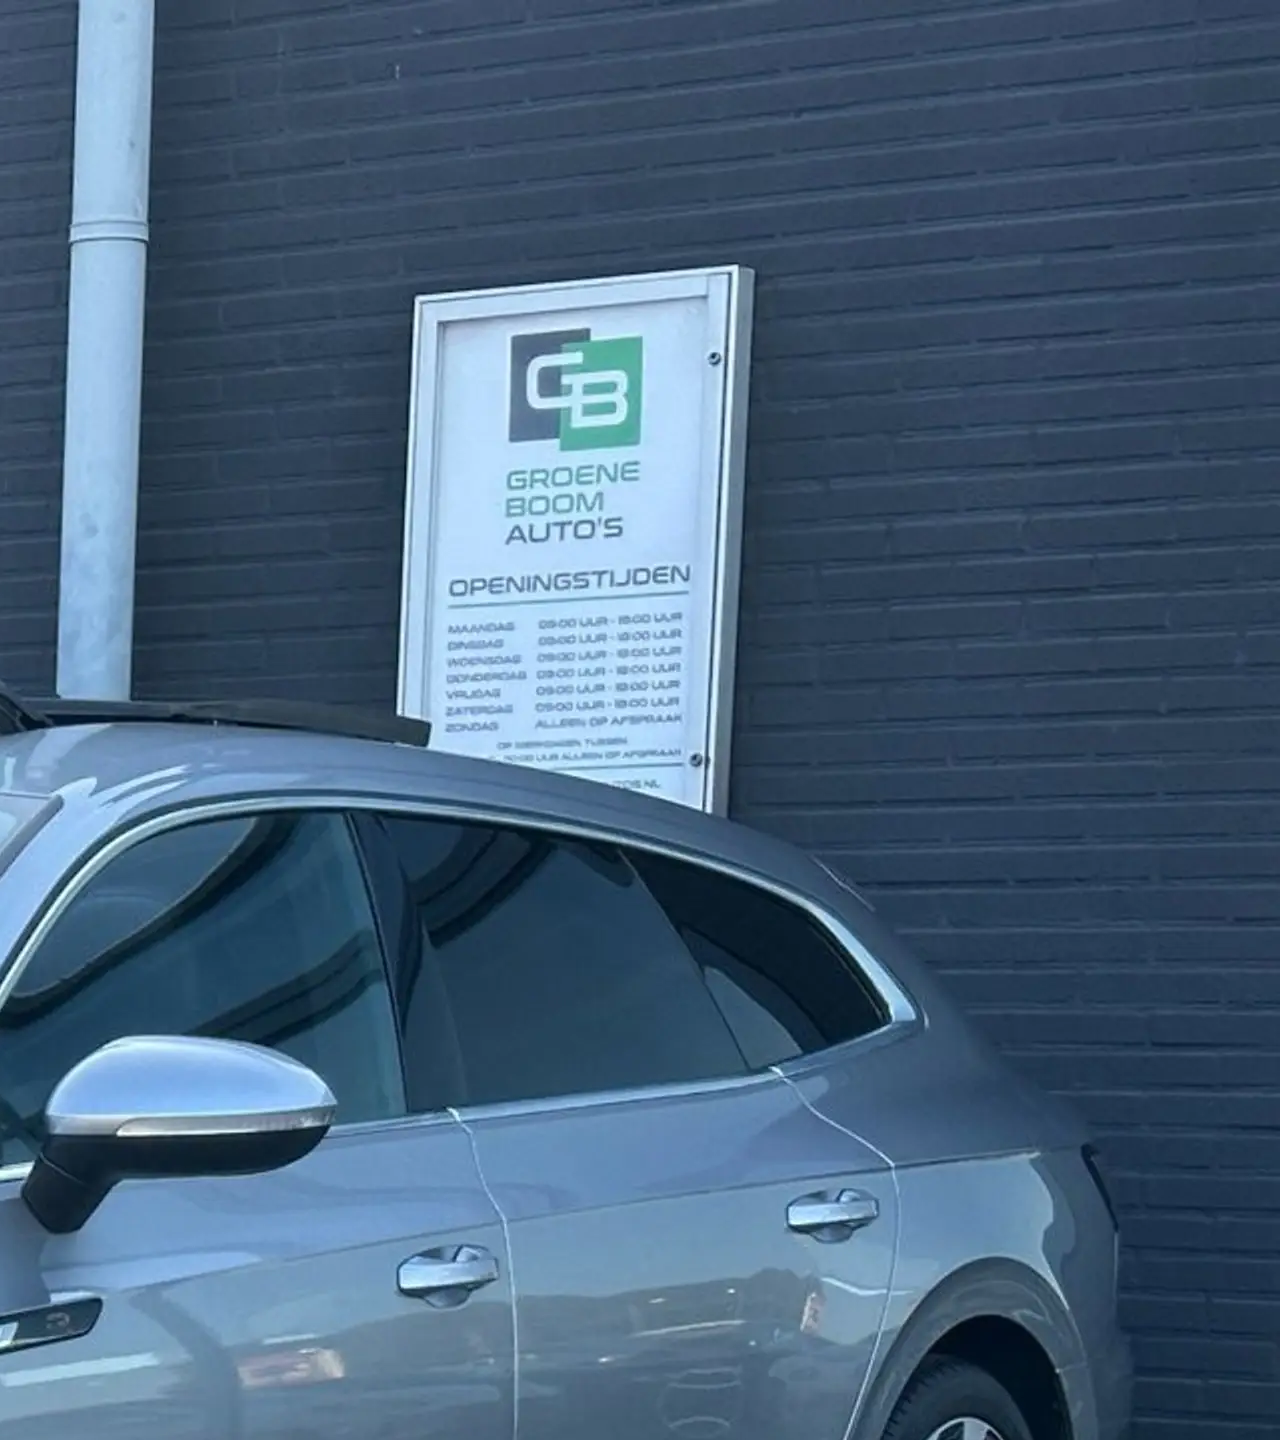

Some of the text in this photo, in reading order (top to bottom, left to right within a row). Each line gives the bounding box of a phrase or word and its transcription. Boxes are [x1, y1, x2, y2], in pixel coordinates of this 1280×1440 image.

[506, 461, 641, 491] GROENE
[505, 491, 604, 518] BOOM
[505, 516, 623, 545] AUTO'S
[449, 565, 691, 598] OPENINGSTIJDEN
